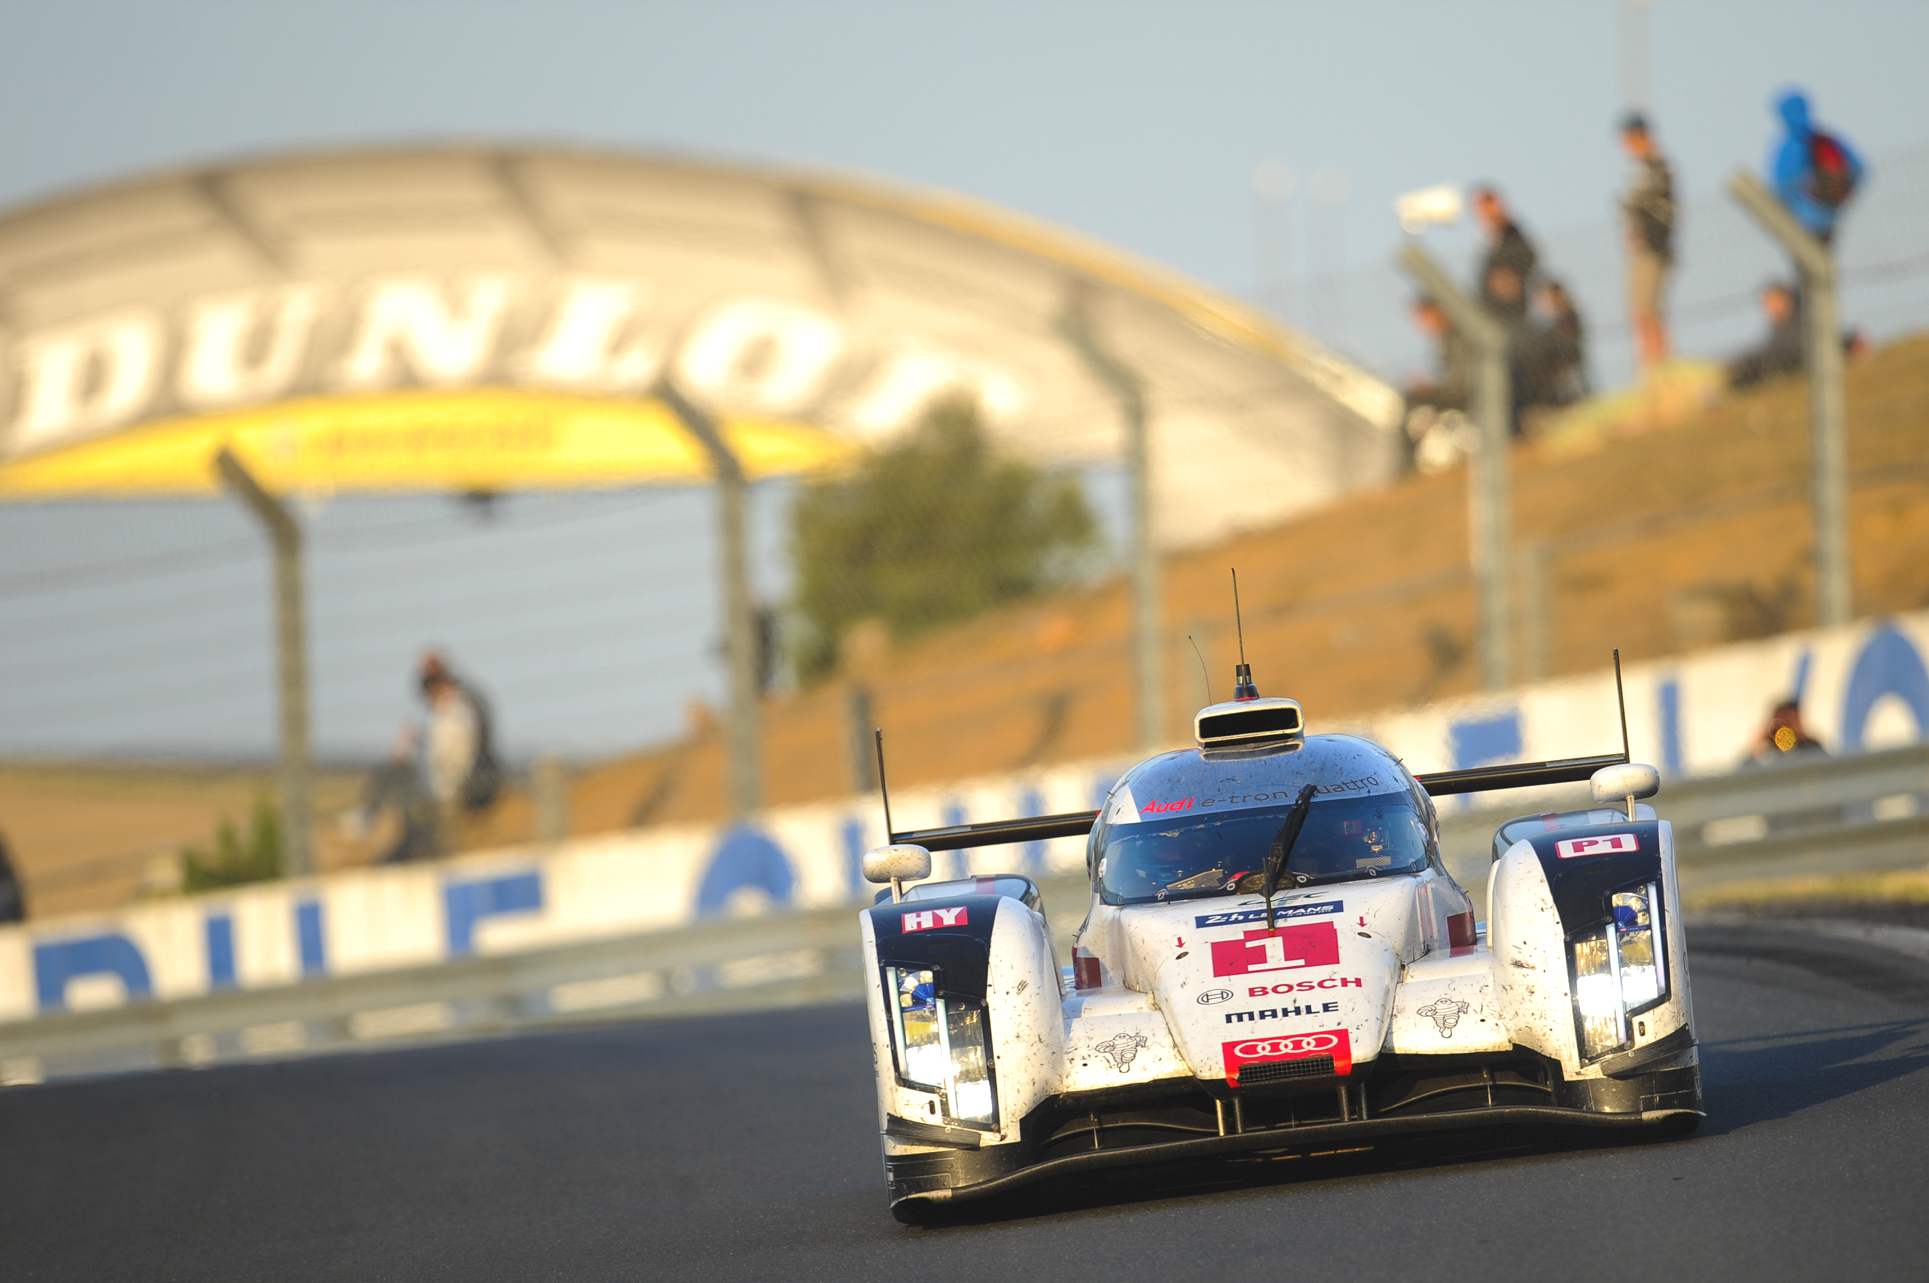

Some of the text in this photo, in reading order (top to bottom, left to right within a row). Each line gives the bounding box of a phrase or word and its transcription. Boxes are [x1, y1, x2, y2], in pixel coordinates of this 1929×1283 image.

[1141, 774, 1380, 815] Audi e-tron uattro
[1572, 836, 1624, 854] P1
[903, 906, 966, 932] HY
[1276, 904, 1335, 917] MANS
[1245, 936, 1306, 972] 1
[1248, 977, 1363, 998] BOSCH
[1225, 1001, 1340, 1024] MAHLE
